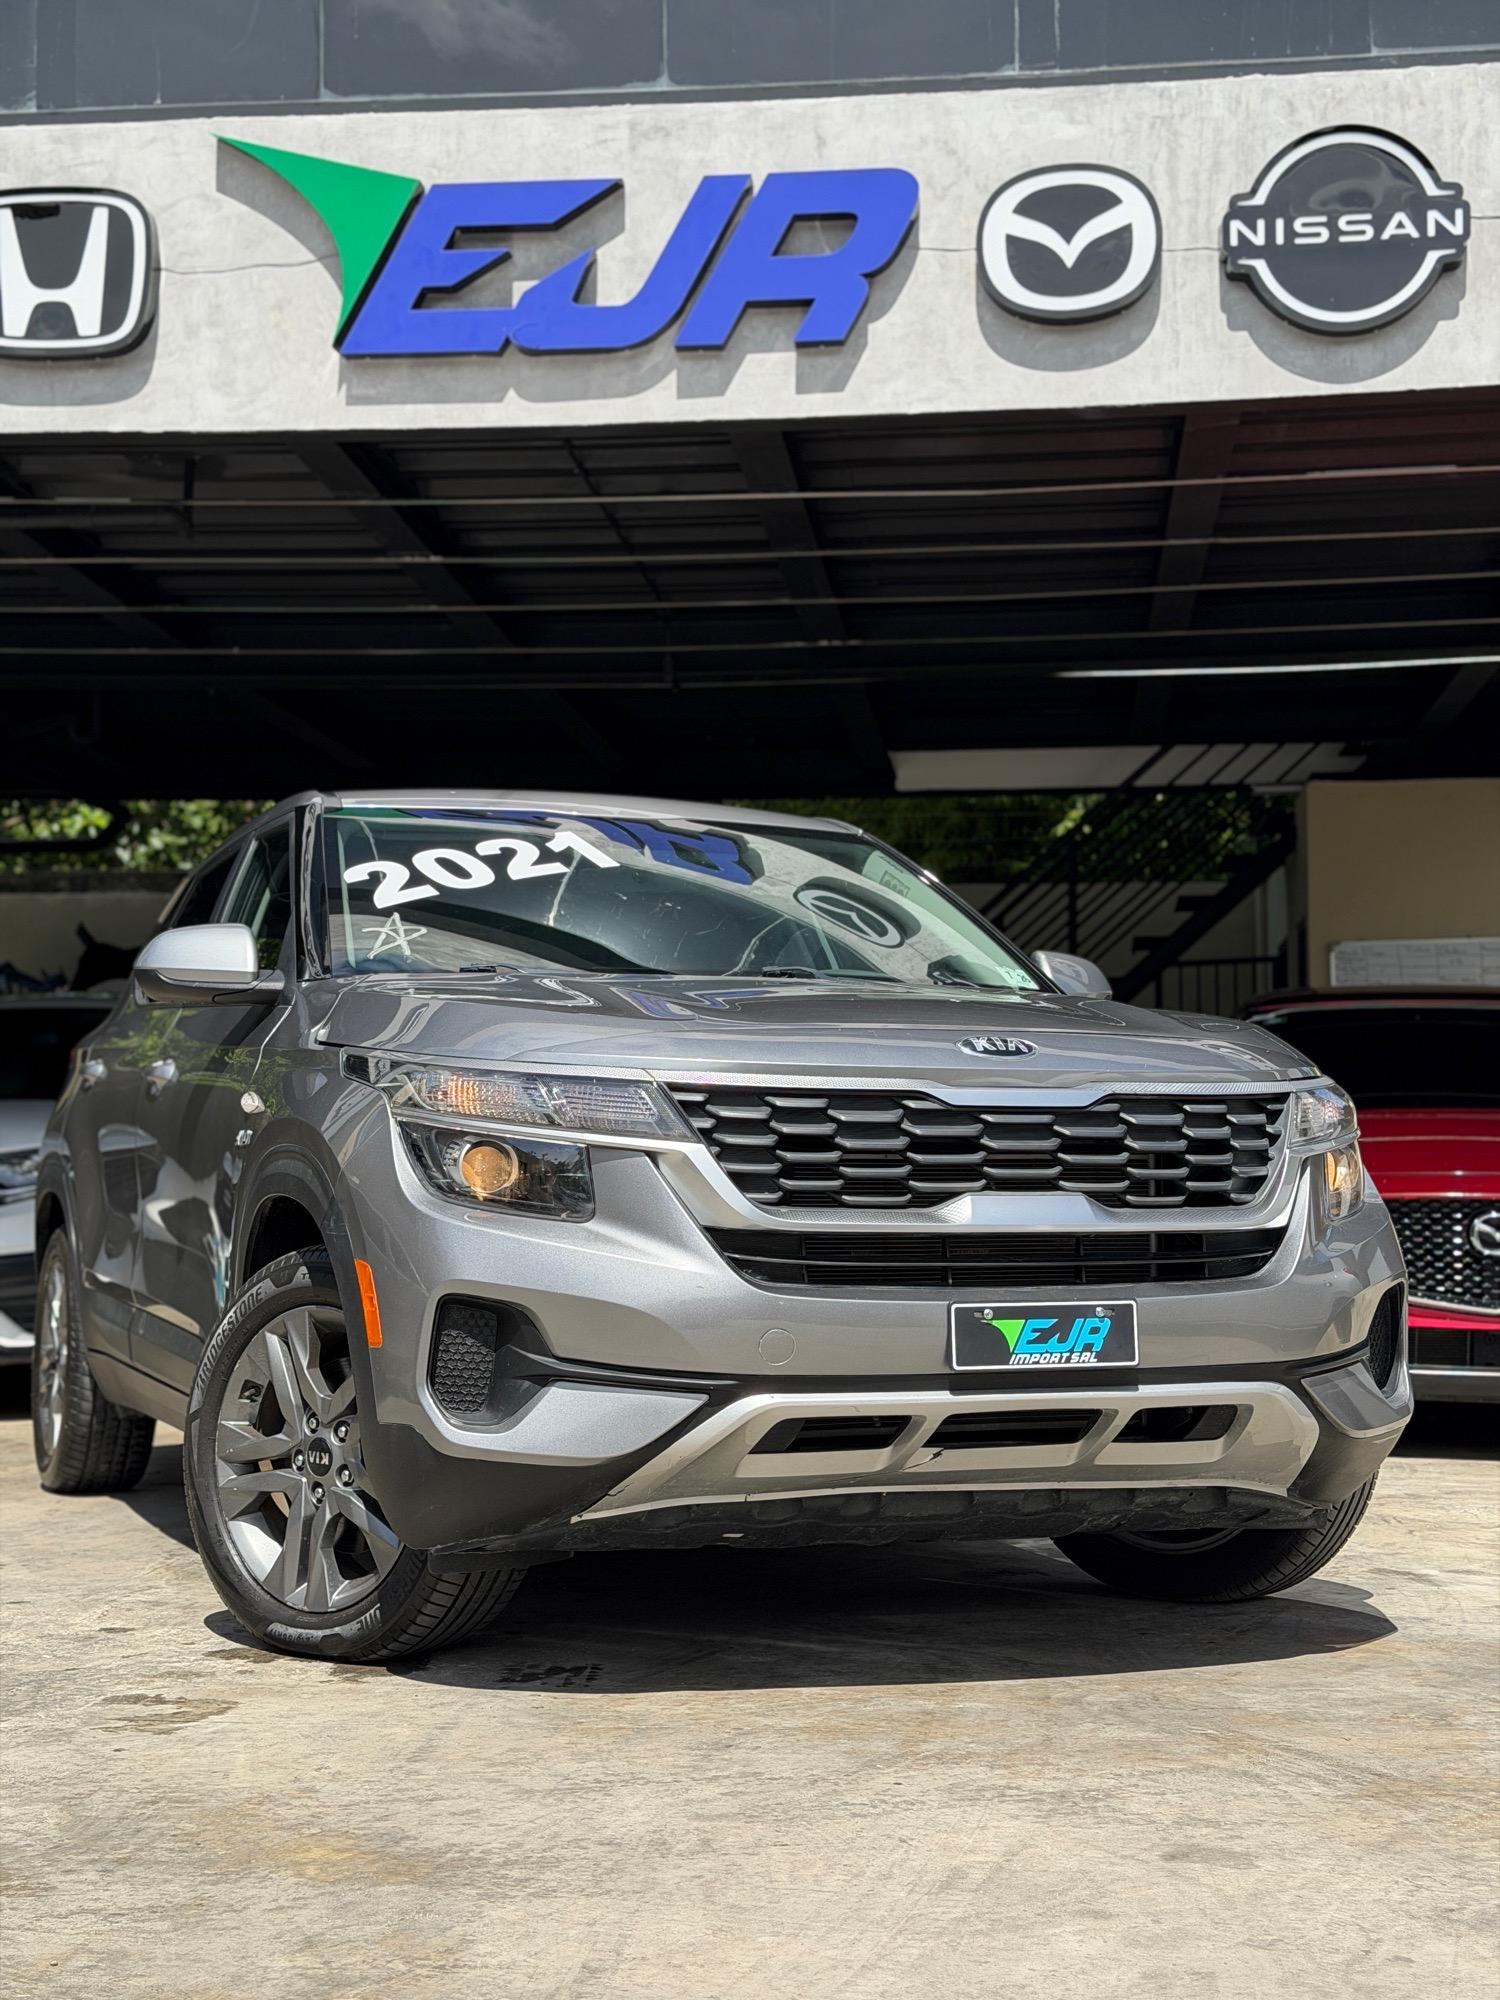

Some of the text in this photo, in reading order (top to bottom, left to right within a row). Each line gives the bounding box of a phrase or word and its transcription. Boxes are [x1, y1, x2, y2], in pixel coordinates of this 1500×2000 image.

[1229, 207, 1464, 247] NISSAN
[340, 168, 919, 357] EJR
[343, 831, 621, 909] 2021
[969, 1036, 1030, 1053] KIA
[195, 1285, 264, 1393] BRIDGESTONE
[1013, 1317, 1111, 1353] EJR
[1009, 1353, 1069, 1365] IMPORT
[308, 1450, 329, 1465] KIA
